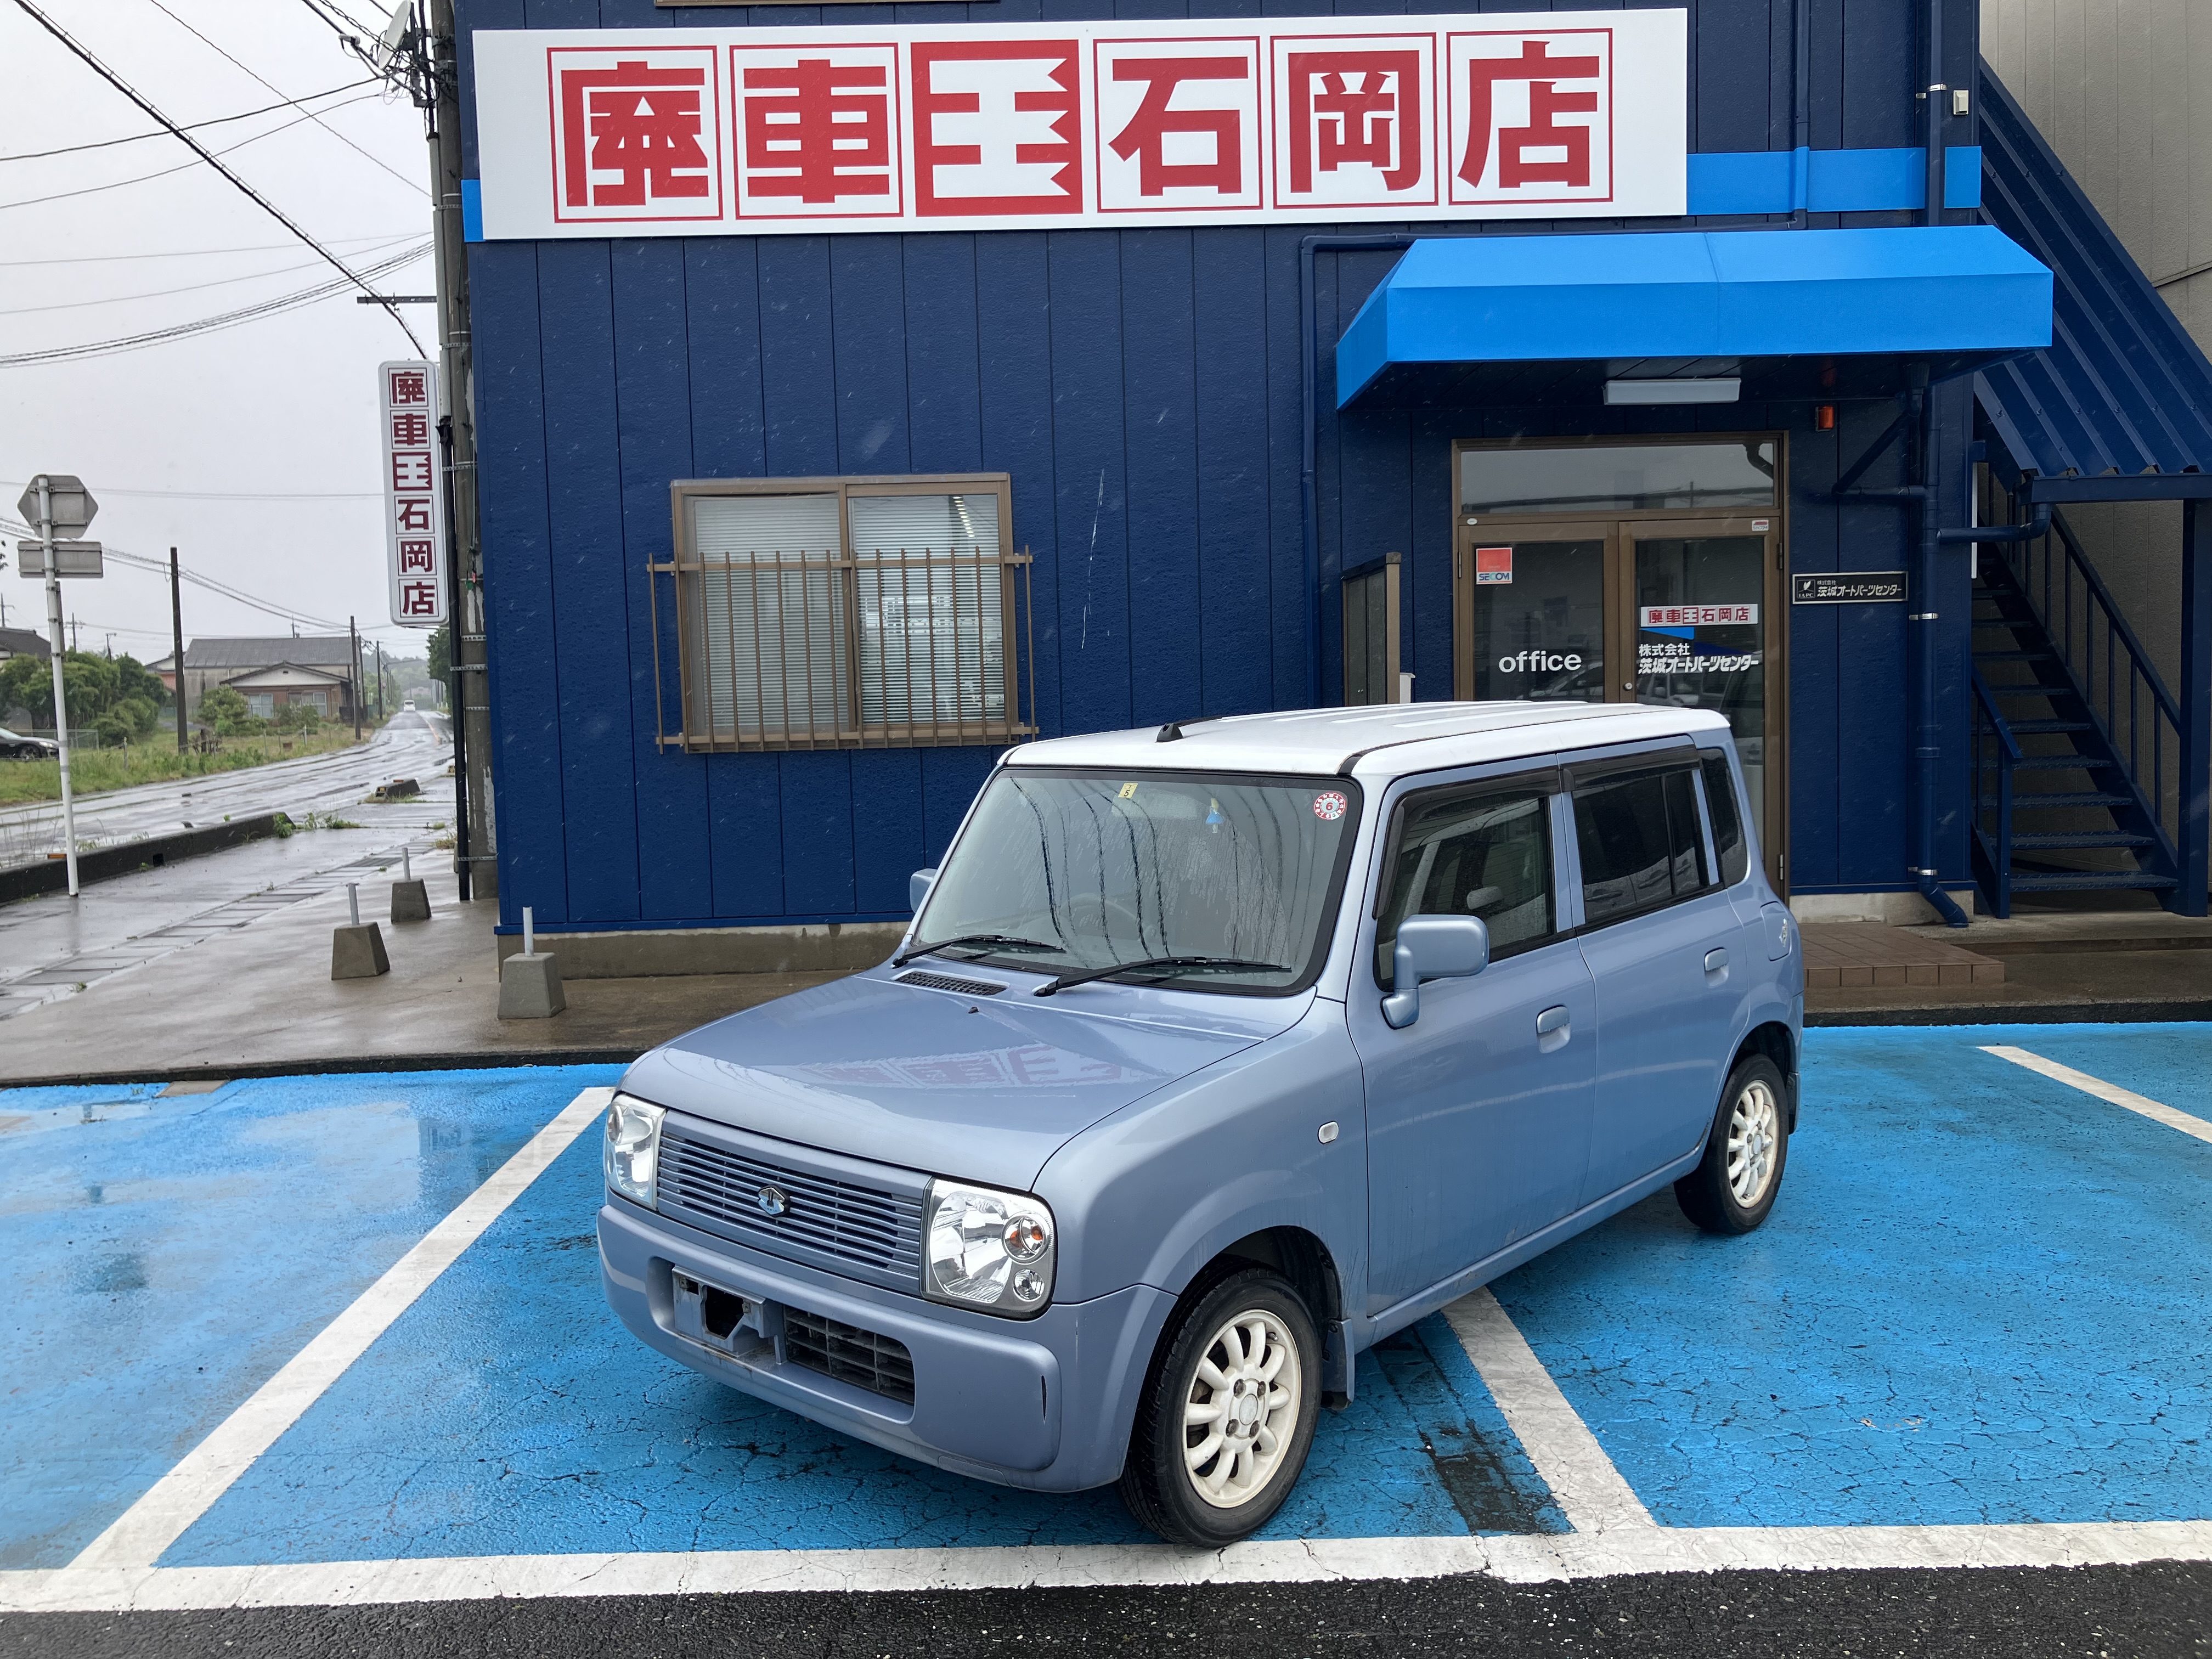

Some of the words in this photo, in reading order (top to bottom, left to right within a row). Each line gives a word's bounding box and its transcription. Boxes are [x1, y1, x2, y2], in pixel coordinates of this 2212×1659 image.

[561, 40, 1599, 217] 廃車王石岡店
[392, 371, 436, 615] 廃車王石岡店
[1479, 572, 1510, 581] SECOM
[1817, 584, 1903, 597] 茨城オートパーツセンター
[1649, 606, 1750, 624] 廃車王石岡店
[1638, 642, 1691, 657] 株式会社
[1498, 650, 1582, 673] office
[1638, 654, 1759, 674] 茨城オートパーツセンター
[1325, 802, 1334, 811] 6
